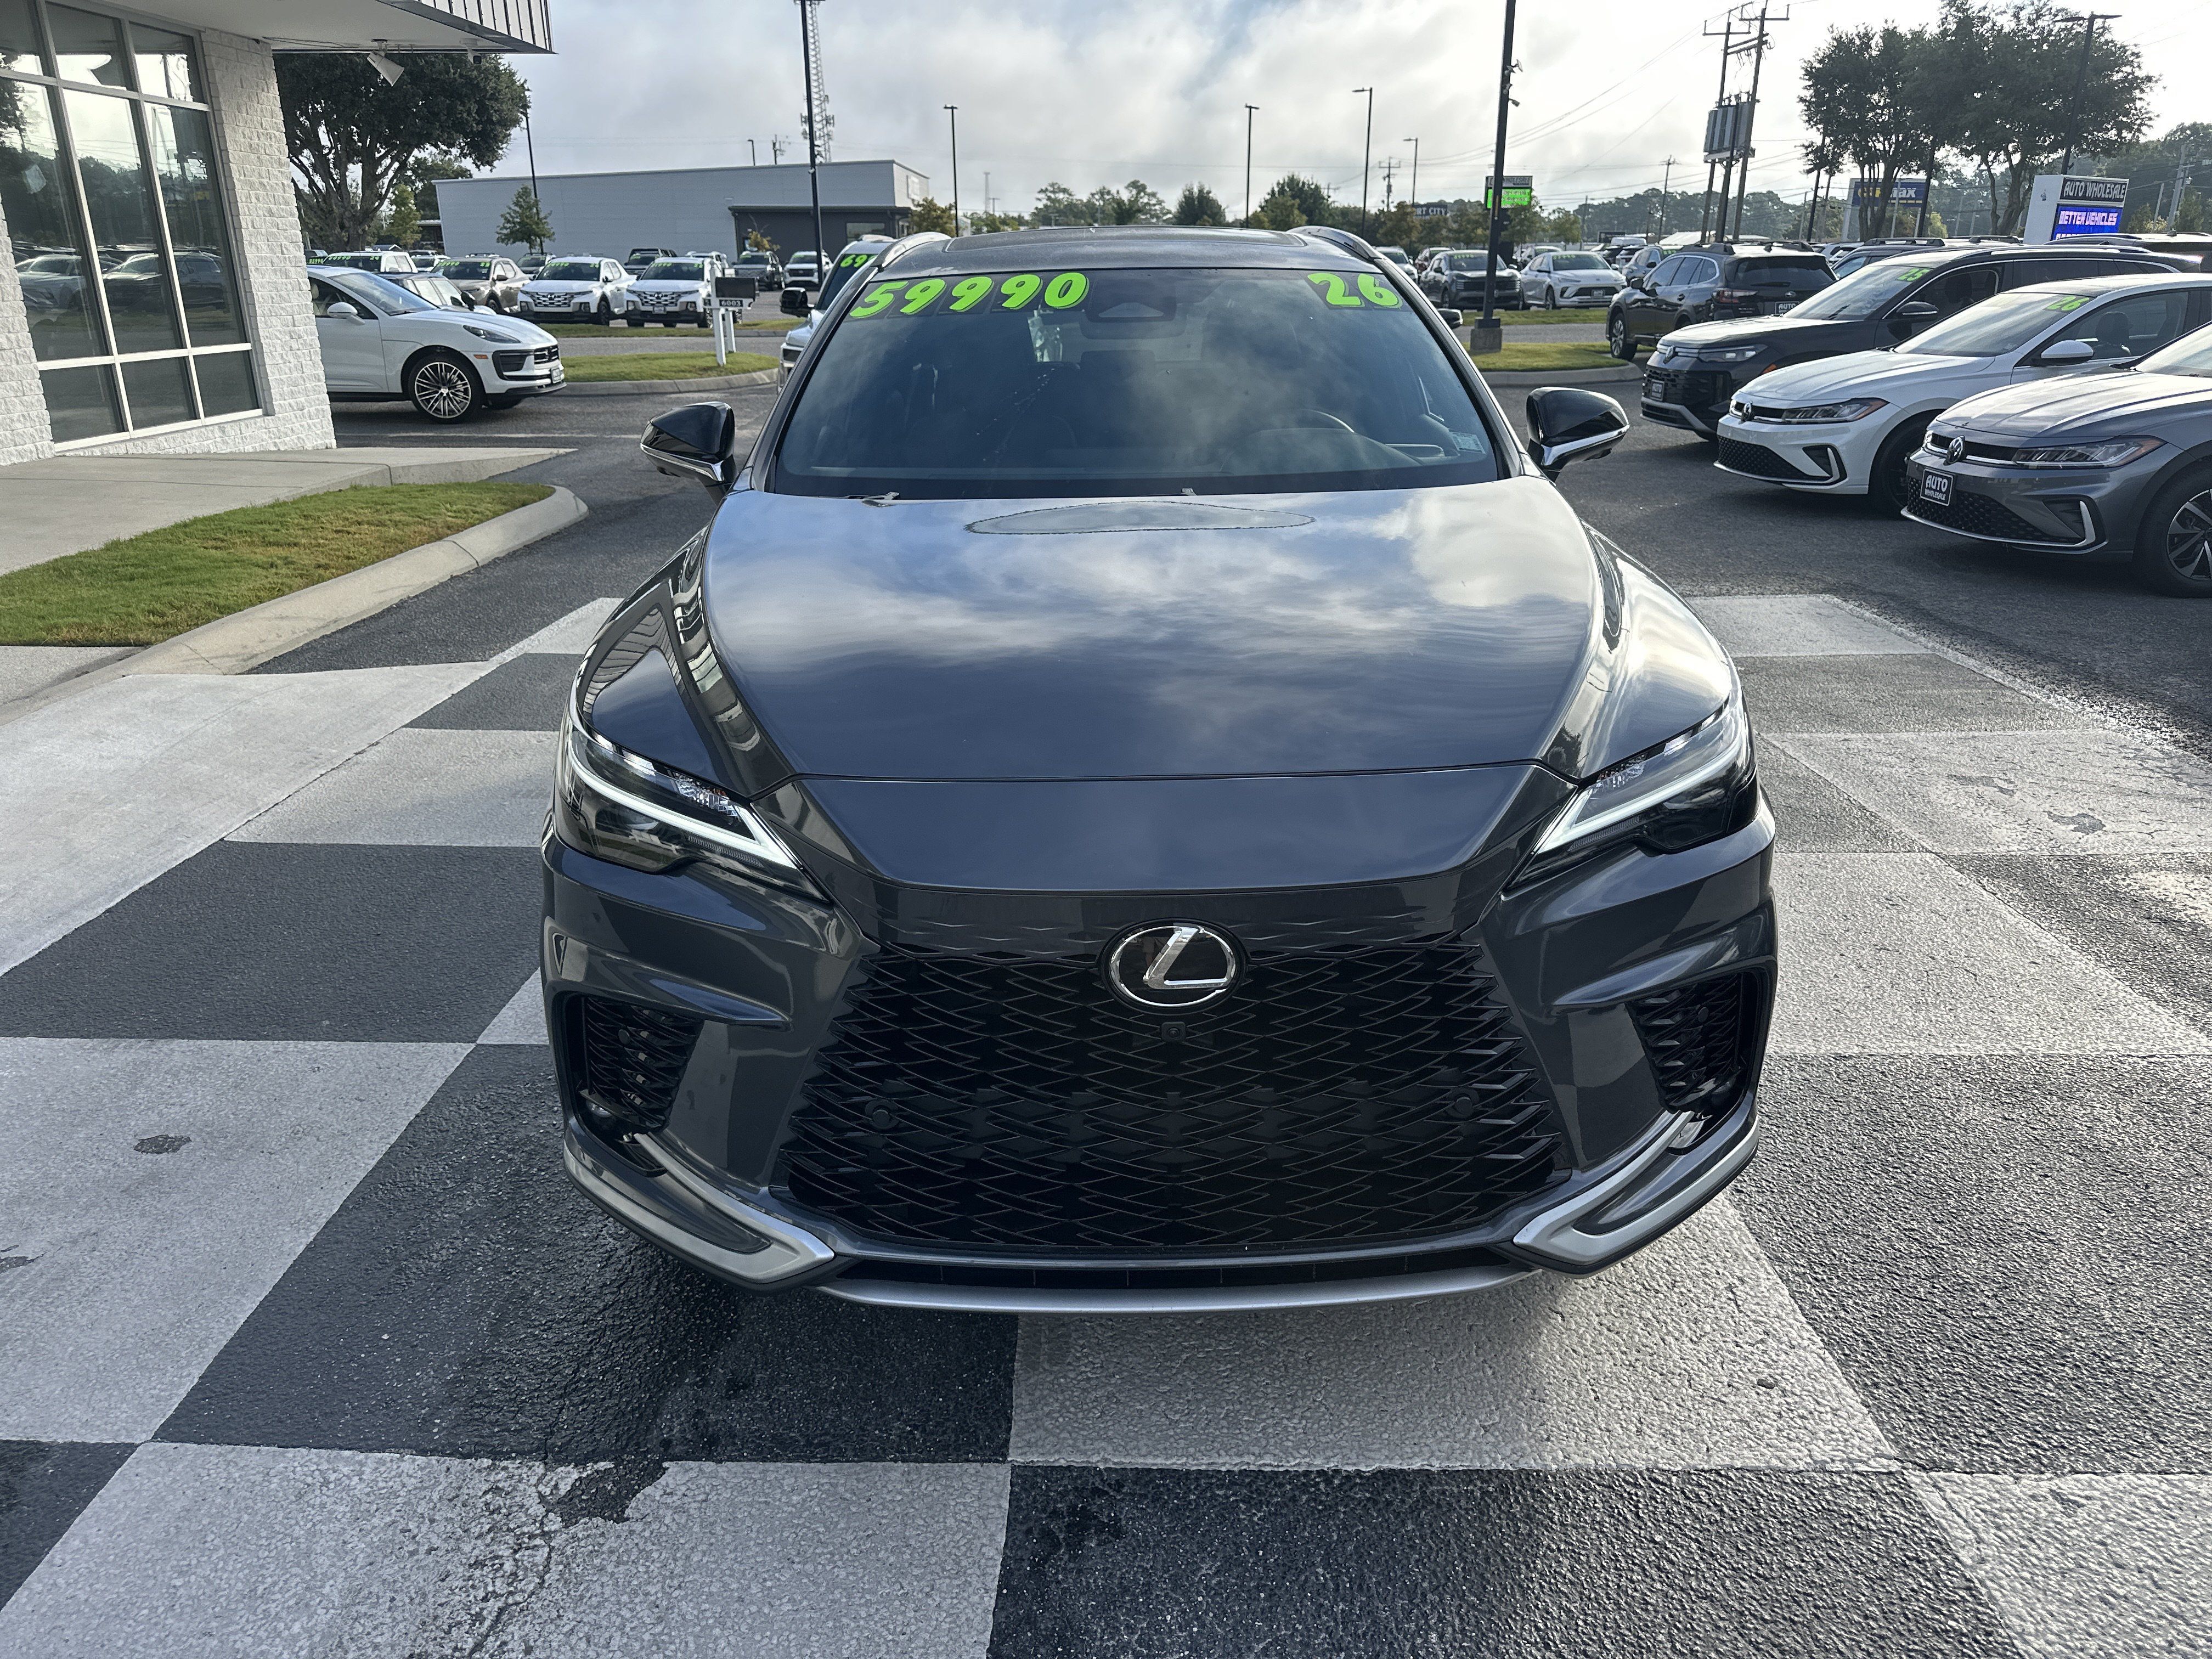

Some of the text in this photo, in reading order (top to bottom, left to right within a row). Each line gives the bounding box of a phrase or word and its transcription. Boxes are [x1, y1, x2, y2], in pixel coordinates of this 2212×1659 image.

[2063, 181, 2126, 200] AUTO WHOLESALE
[2058, 211, 2118, 226] BETTER VEHICLES
[1897, 268, 1930, 281] 25
[850, 272, 1404, 318] 59990 26
[2046, 296, 2090, 311] 26
[1926, 475, 1948, 492] AUTO
